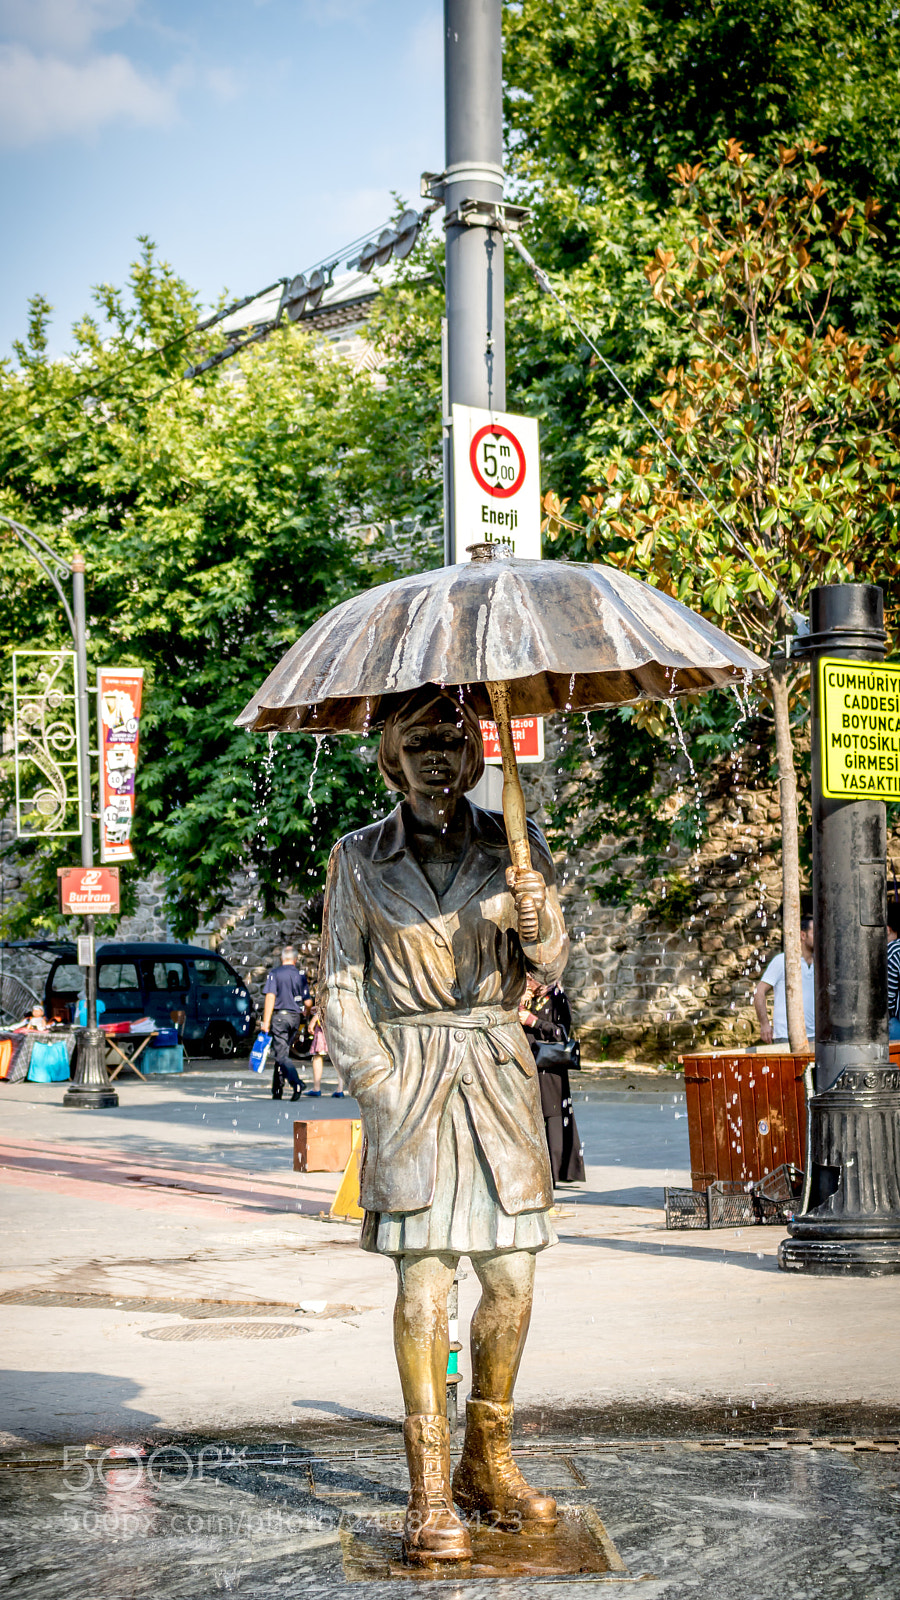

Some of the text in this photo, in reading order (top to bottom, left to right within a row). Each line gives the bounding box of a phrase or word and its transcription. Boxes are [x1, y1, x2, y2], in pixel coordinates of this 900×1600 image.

[481, 505, 518, 531] Enerji
[844, 693, 899, 713] CADDESİ
[844, 750, 899, 772] GİRMESİ
